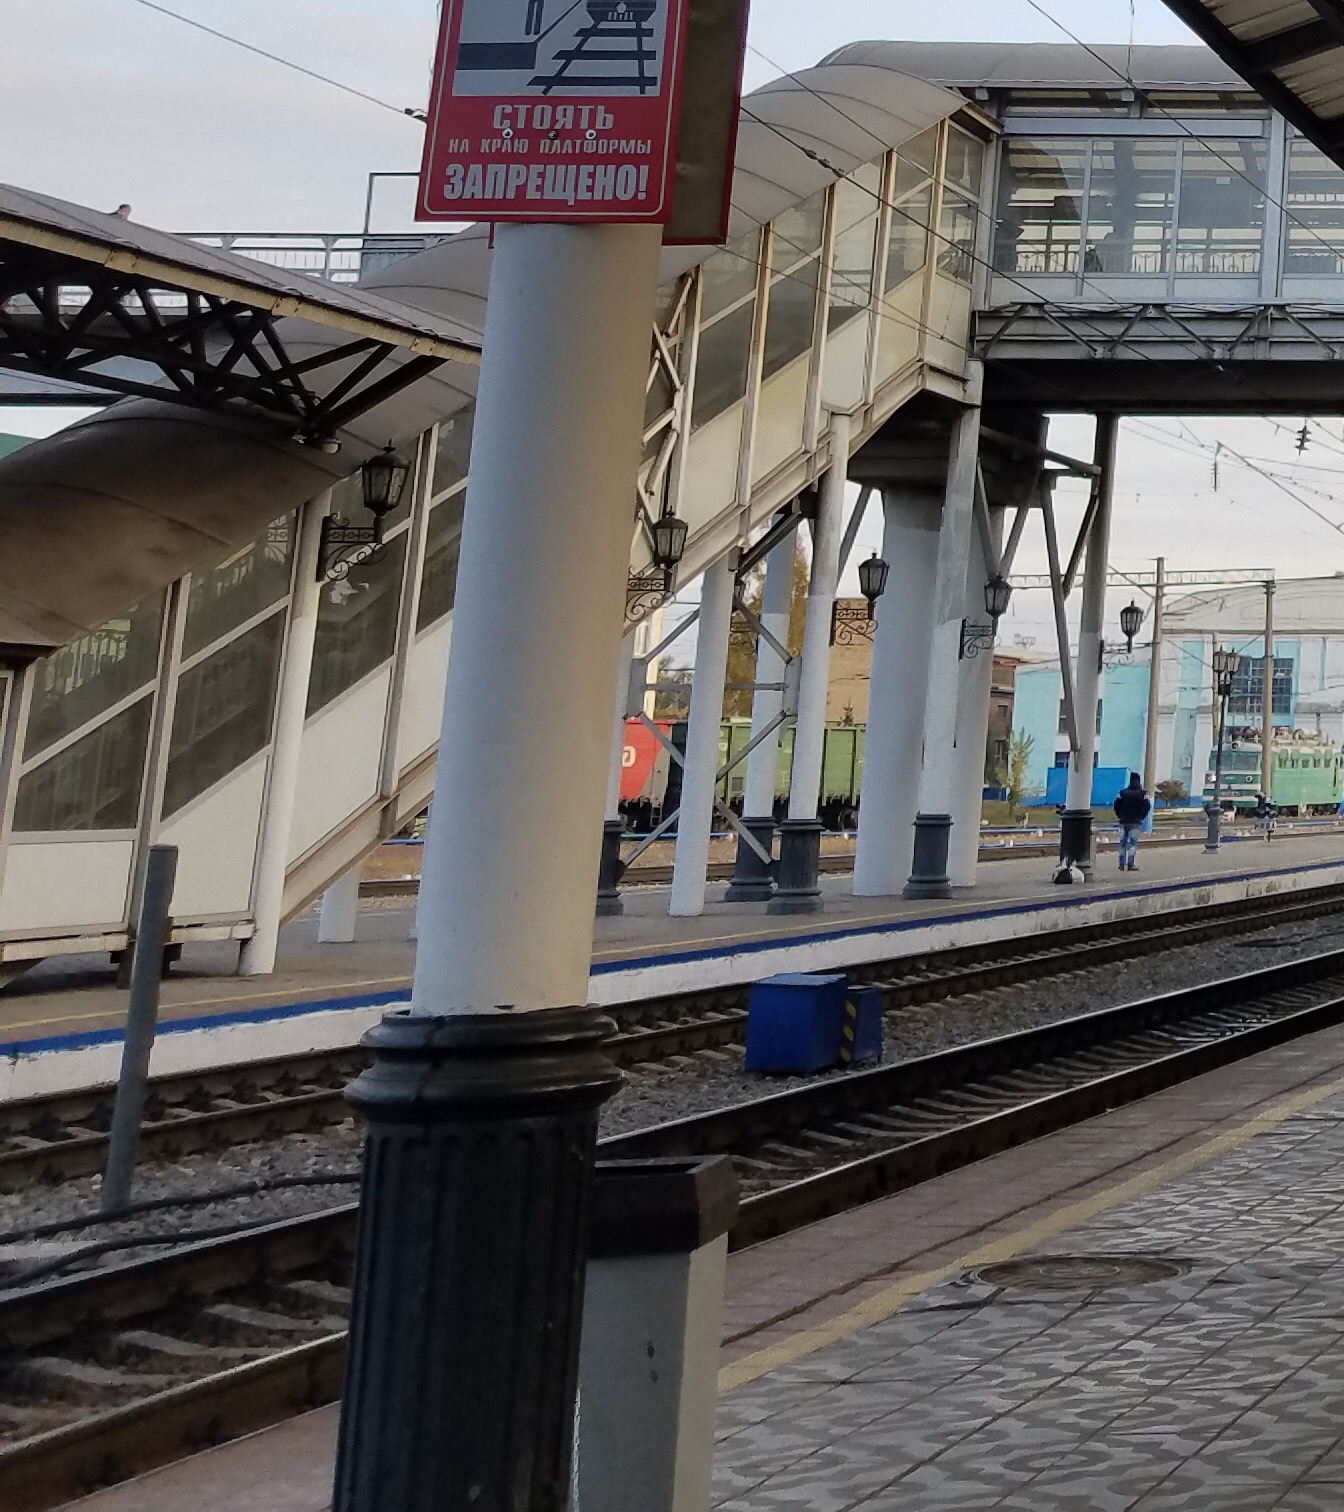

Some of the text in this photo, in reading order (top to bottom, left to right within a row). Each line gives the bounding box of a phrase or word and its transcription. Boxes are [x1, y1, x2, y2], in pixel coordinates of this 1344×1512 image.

[493, 104, 614, 130] СТОЯТЬ
[448, 138, 652, 155] НА КРАЮ ПЛАТФОРМЫ
[443, 163, 650, 206] ЗАПРЕЩЕНО!
